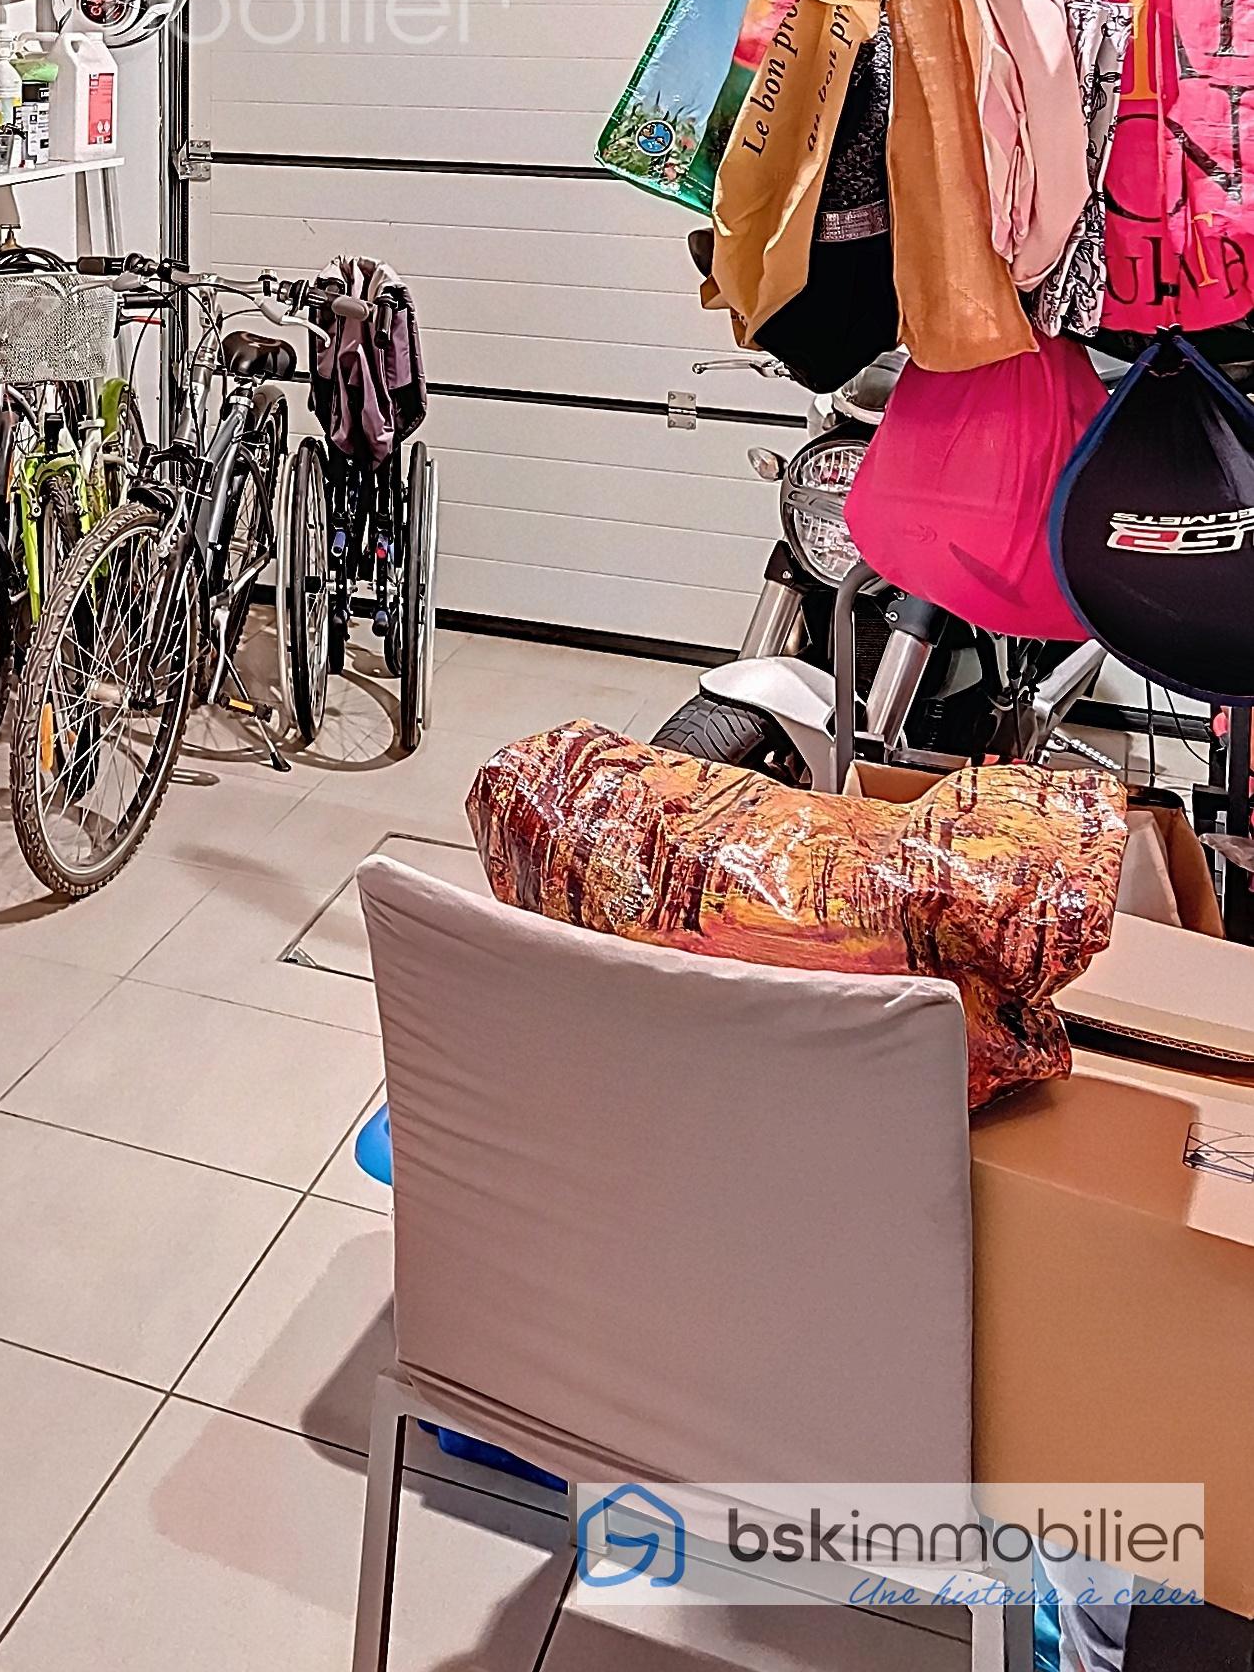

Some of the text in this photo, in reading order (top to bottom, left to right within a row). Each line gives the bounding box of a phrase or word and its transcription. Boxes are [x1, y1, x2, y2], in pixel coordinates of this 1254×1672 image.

[829, 3, 854, 50] pr
[750, 57, 786, 113] bon
[741, 119, 770, 158] Le
[1111, 508, 1254, 526] ELMETS
